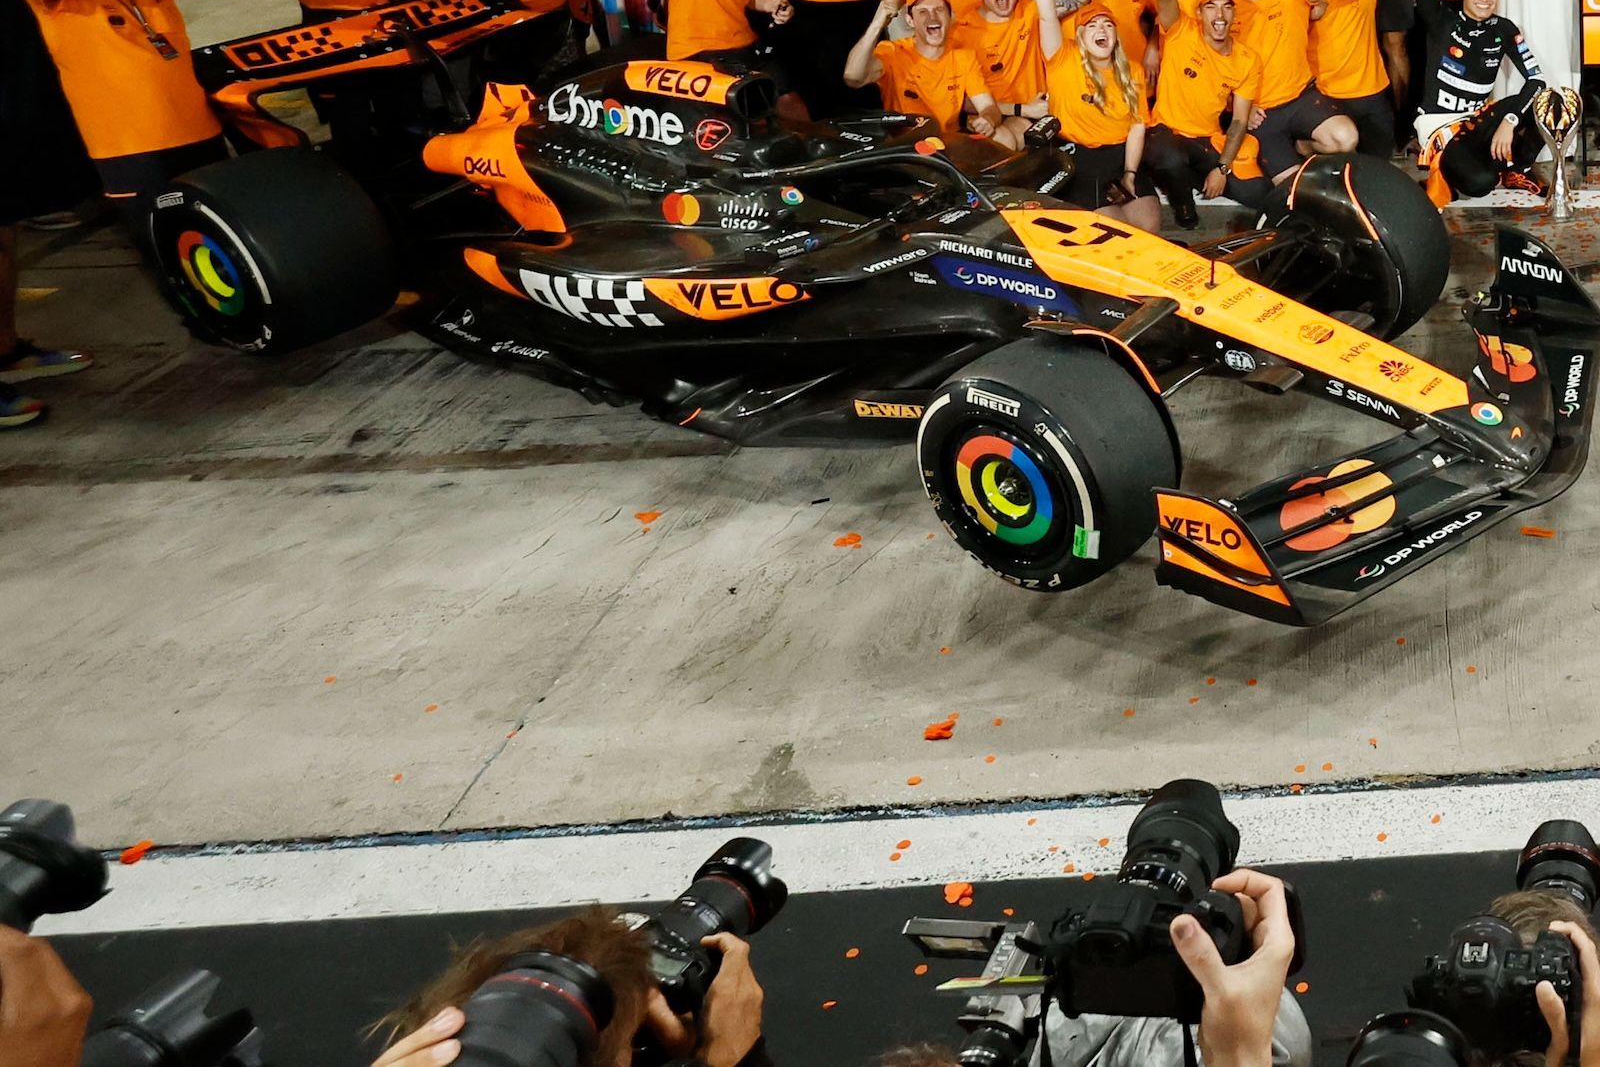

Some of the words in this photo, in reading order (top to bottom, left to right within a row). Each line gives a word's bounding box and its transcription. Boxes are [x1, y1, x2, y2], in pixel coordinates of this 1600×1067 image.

[646, 66, 711, 97] VELO
[548, 83, 684, 145] Chrome
[840, 131, 872, 143] VELO
[464, 156, 506, 178] DELL
[721, 217, 758, 230] CISCO
[863, 248, 927, 273] vmware
[940, 240, 994, 259] RICHARD
[996, 252, 1033, 269] MILLE
[976, 273, 998, 287] DP
[999, 278, 1057, 301] WORLD
[1170, 265, 1206, 287] Hilton
[677, 282, 802, 310] VELO
[1219, 286, 1254, 310] alteryx
[1254, 301, 1285, 324] webex
[509, 347, 549, 359] KAUST
[1339, 340, 1371, 364] FxPro
[1391, 364, 1415, 382] CNBC
[1567, 354, 1585, 387] WORLD
[966, 386, 1021, 418] PIRELLI
[1346, 389, 1401, 420] SENNA
[1564, 388, 1578, 403] DP
[1163, 515, 1242, 551] VELO
[1384, 546, 1412, 567] DP
[1411, 510, 1484, 552] WORLD
